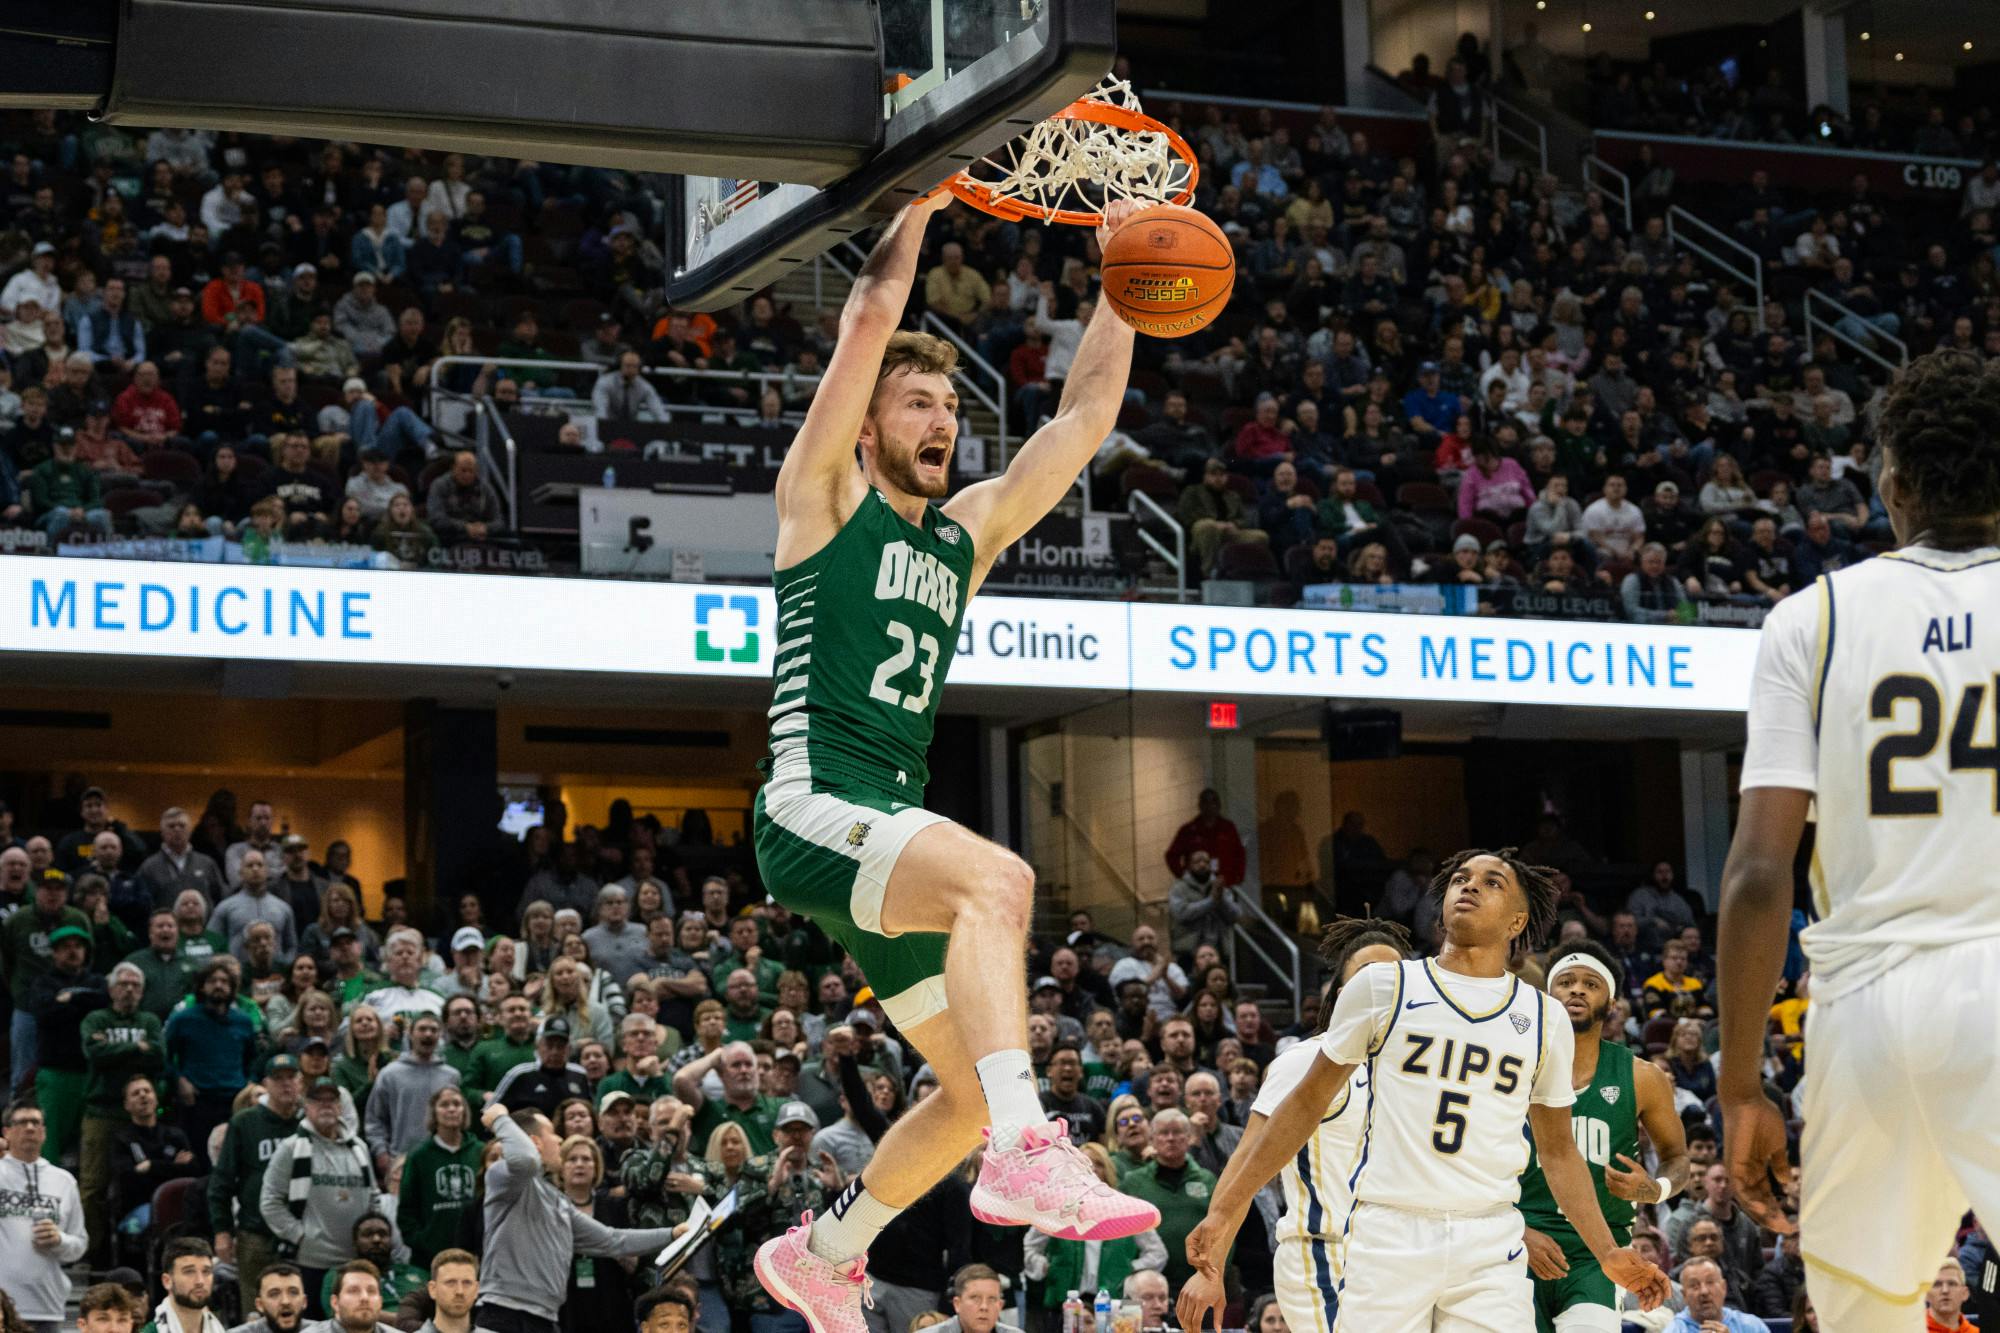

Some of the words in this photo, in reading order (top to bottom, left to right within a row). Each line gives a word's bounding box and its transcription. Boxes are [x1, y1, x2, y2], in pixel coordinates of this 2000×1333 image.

[1904, 164, 1919, 187] C
[1922, 164, 1961, 190] 109
[1123, 287, 1199, 302] LEGACY
[1119, 308, 1206, 332] SPALDING
[1092, 527, 1102, 545] 2
[426, 545, 480, 565] CLUB
[486, 550, 549, 570] LEVEL
[874, 540, 960, 628] OHIO
[1512, 594, 1557, 611] CLUB
[1562, 597, 1616, 616] LEVEL
[30, 579, 373, 640] MEDICINE
[989, 620, 1099, 660] Clinic
[1922, 613, 1973, 655] ALI
[868, 619, 940, 714] 23
[1168, 625, 1391, 677] SPORTS
[1419, 635, 1695, 689] MEDICINE
[1868, 671, 2000, 818] 24
[1401, 1033, 1524, 1096] ZIPS
[1431, 1088, 1472, 1159] 5
